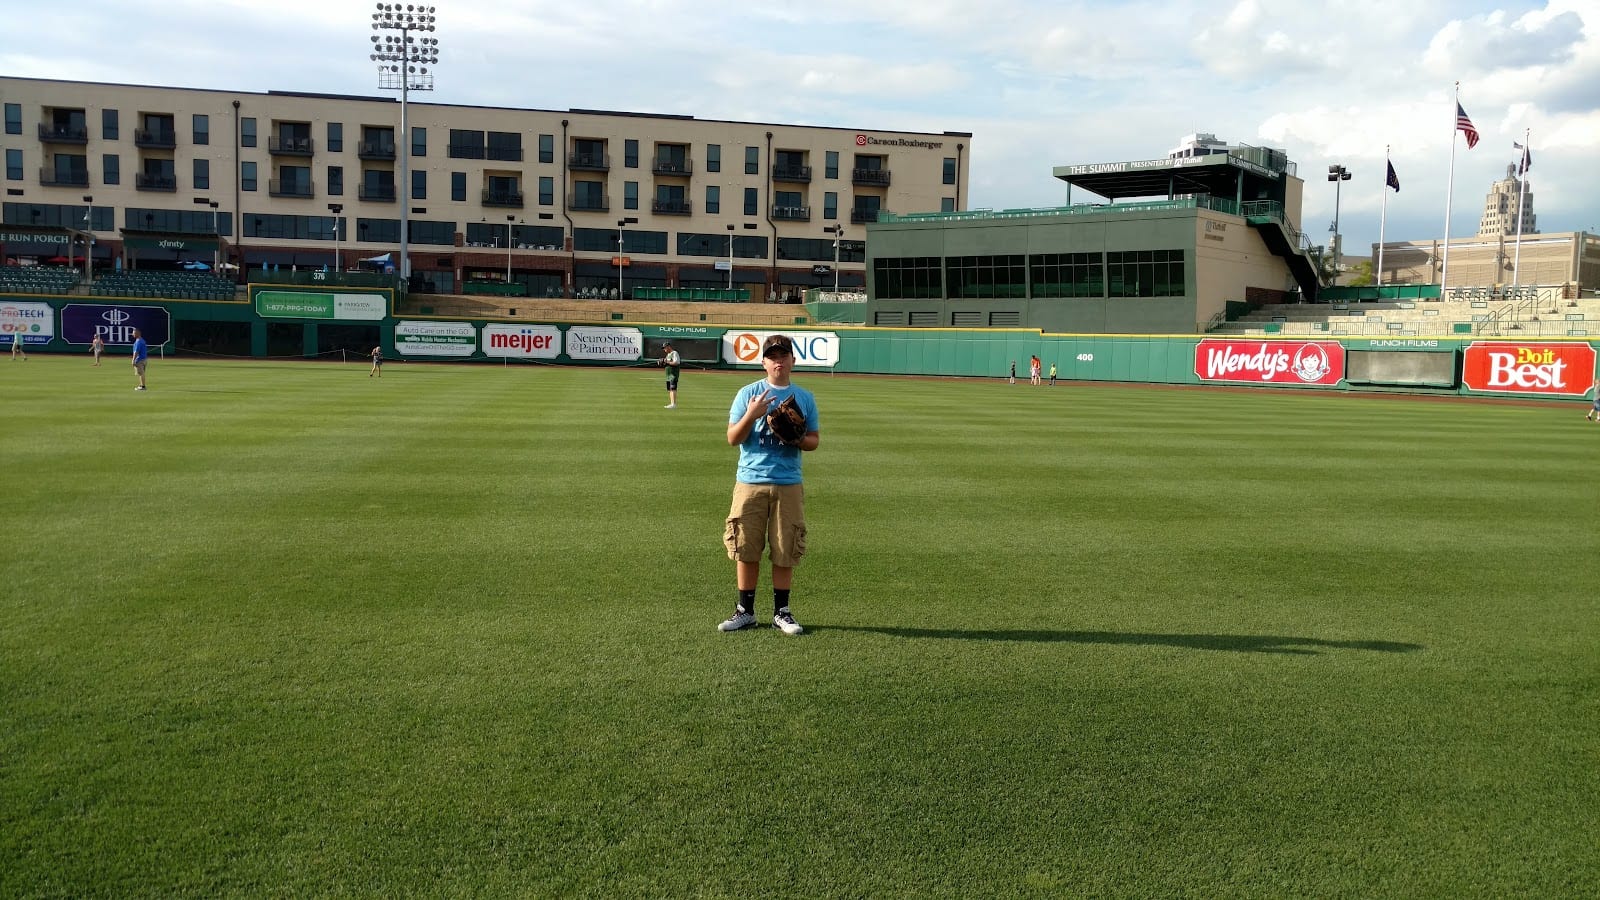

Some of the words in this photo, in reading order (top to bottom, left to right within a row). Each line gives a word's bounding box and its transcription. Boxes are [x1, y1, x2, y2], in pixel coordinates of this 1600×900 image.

[867, 137, 897, 146] Carson
[899, 139, 943, 149] Boxberger
[1070, 165, 1086, 175] THE
[1089, 162, 1127, 174] SUMMIT
[1131, 160, 1164, 168] PRESENTED
[33, 234, 69, 243] PORCH
[159, 240, 185, 248] xfinity
[265, 304, 327, 312] 1-877-PPG-TODAY
[490, 329, 552, 352] meijer
[572, 332, 636, 346] NeuroSpine
[1076, 353, 1094, 361] 400
[1207, 343, 1290, 380] Wendy's
[1516, 347, 1542, 364] Do
[1543, 348, 1556, 364] it
[1487, 352, 1568, 388] Best
